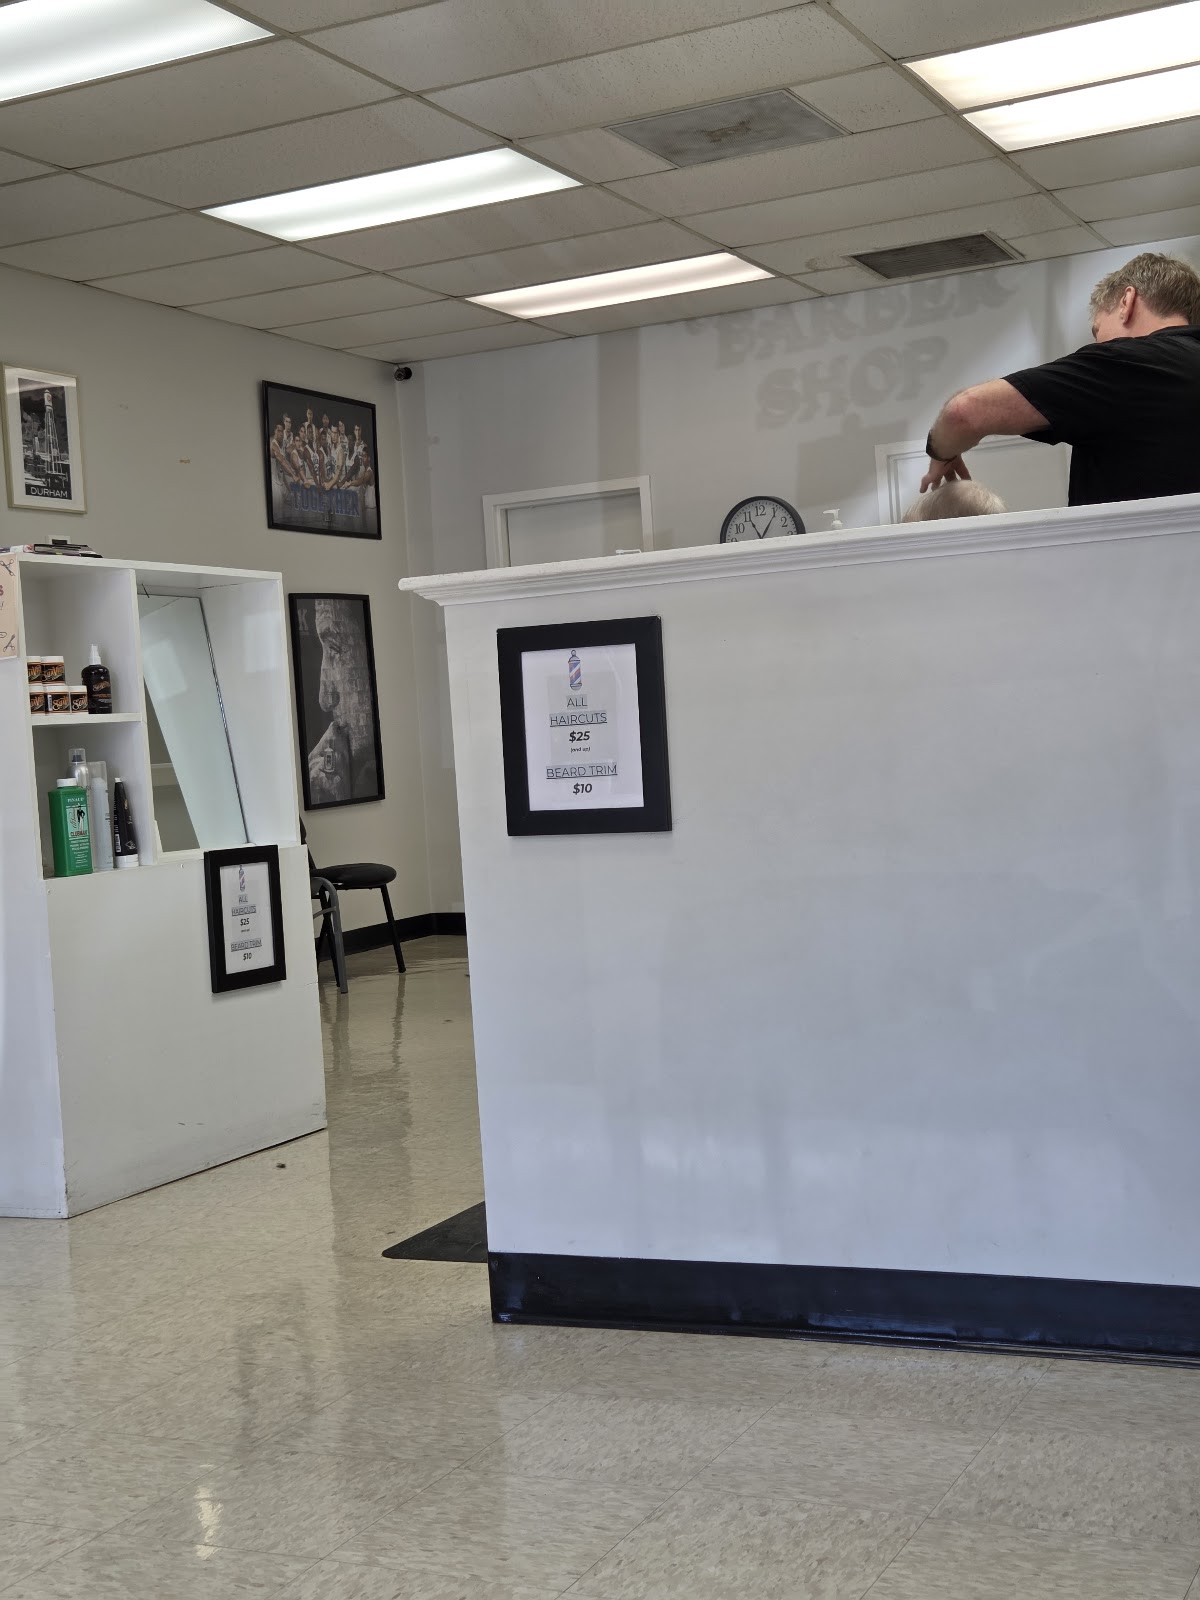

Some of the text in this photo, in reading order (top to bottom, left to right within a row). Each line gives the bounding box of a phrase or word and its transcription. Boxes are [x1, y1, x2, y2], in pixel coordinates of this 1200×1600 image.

[755, 335, 949, 430] SHOP
[30, 486, 68, 498] DURHAM
[744, 511, 752, 523] 11
[755, 505, 766, 517] 12
[735, 522, 745, 534] 10
[781, 516, 788, 528] 2
[297, 608, 309, 631] K
[567, 697, 588, 708] ALL
[549, 712, 607, 727] HAIRCUTS
[569, 730, 590, 743] $25
[546, 764, 618, 779] BEARD TRIM
[573, 782, 593, 795] $10
[238, 896, 248, 904] ALL
[231, 905, 257, 917] HAIRCUTS
[240, 917, 250, 926] $25
[243, 952, 253, 961] $10
